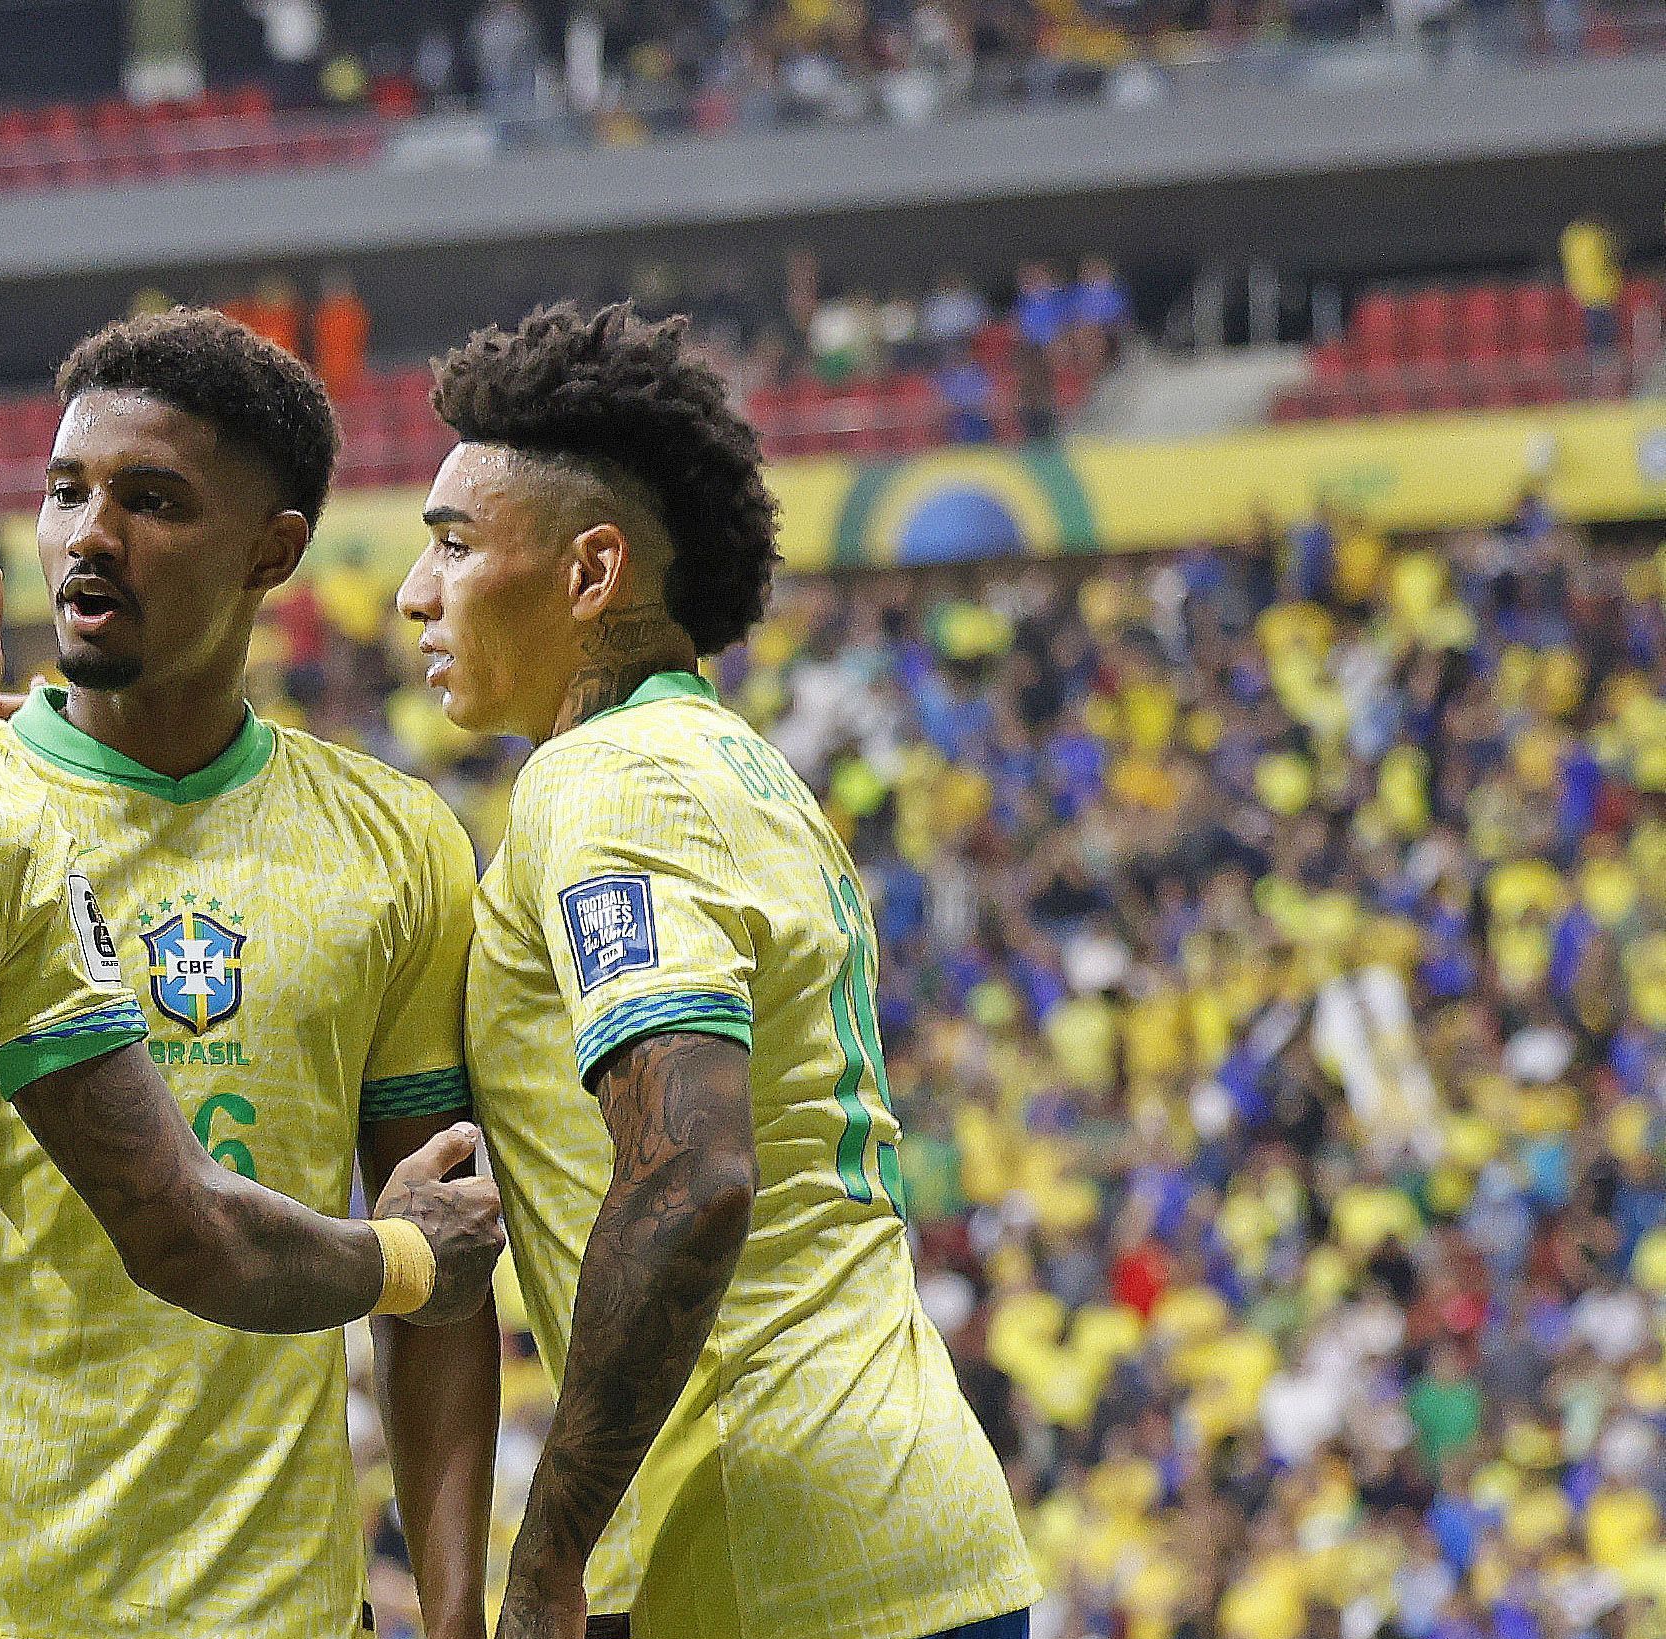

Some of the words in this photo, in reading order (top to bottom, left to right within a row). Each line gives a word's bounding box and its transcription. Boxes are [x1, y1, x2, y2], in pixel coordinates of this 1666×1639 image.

[576, 889, 632, 917] FOOTBALL
[579, 905, 634, 936] UNITES
[176, 959, 214, 975] CBF
[151, 1039, 250, 1066] BRASIL
